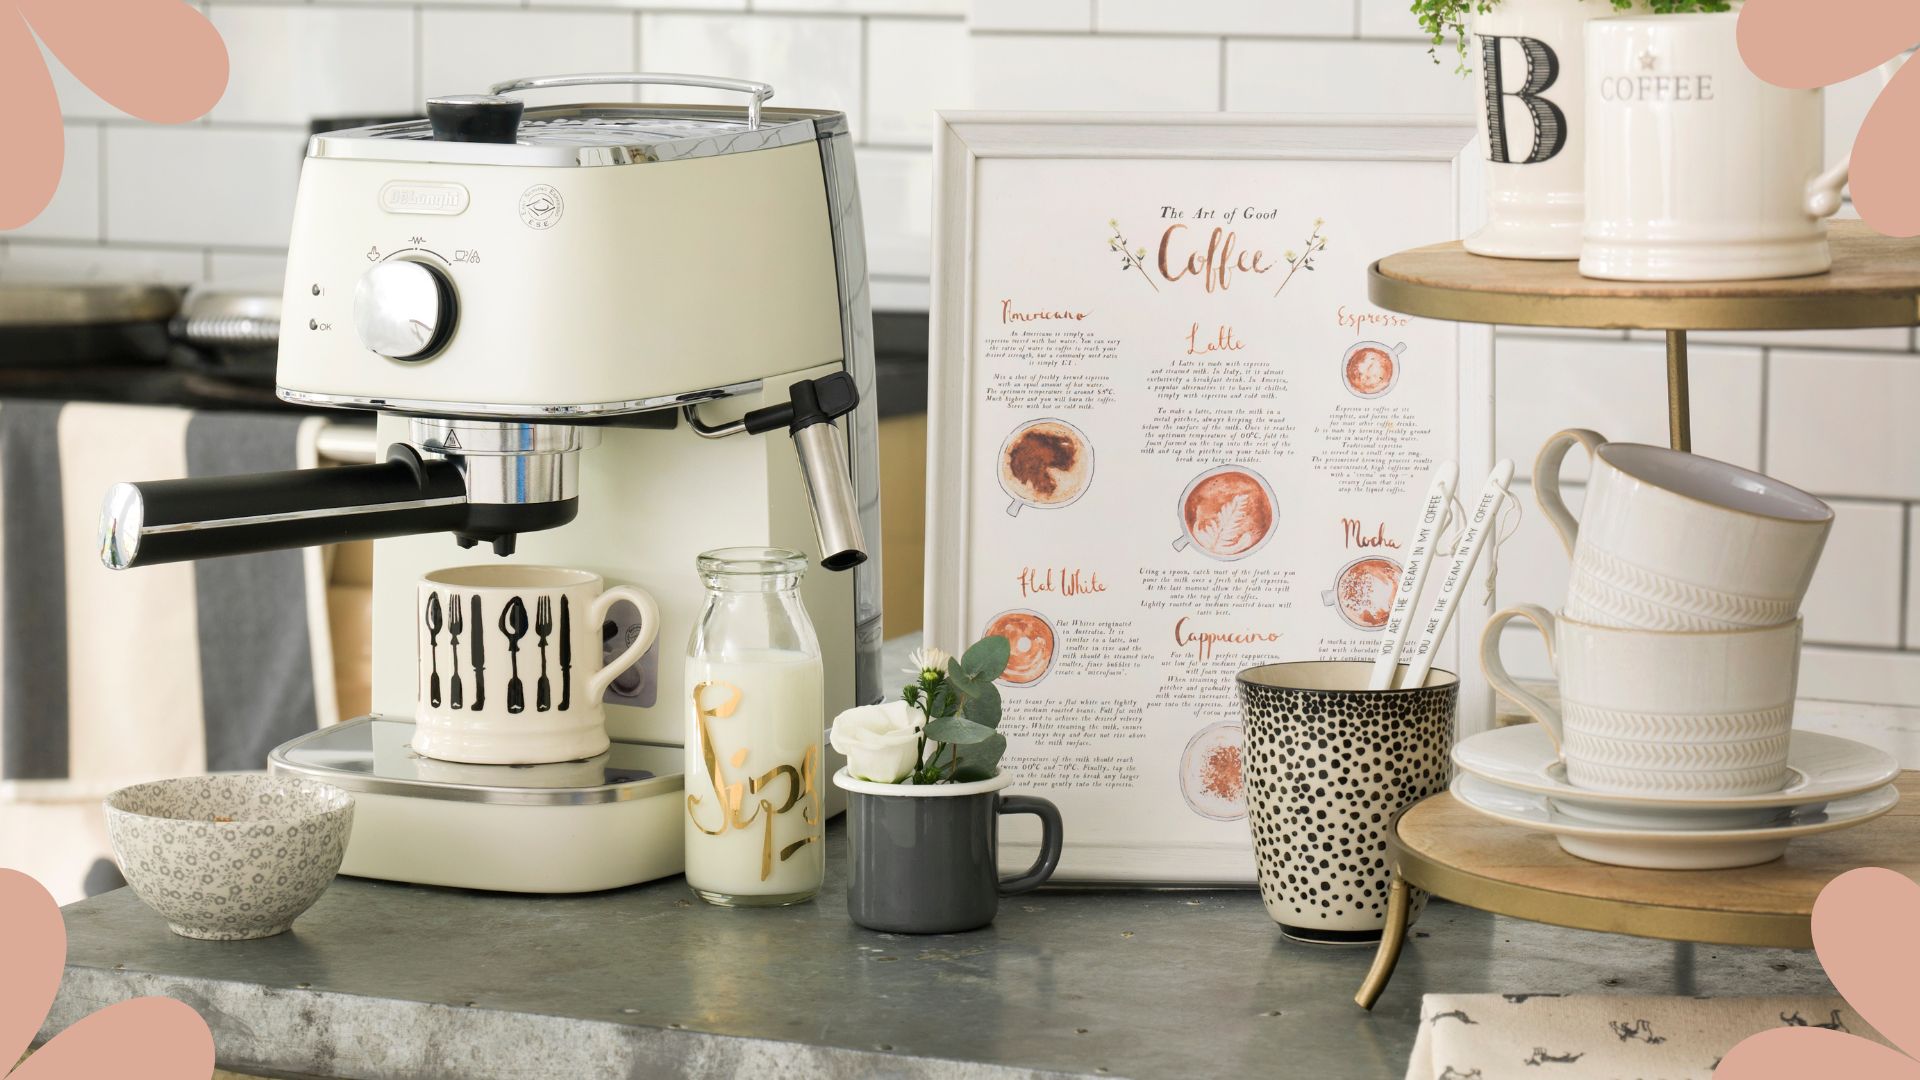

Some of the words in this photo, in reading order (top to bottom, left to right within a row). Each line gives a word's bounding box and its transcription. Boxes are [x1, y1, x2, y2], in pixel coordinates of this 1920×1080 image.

[1473, 32, 1568, 164] B
[1600, 74, 1715, 102] COFFEE
[1160, 206, 1184, 219] The
[1192, 207, 1215, 219] Art
[1224, 207, 1238, 224] of
[1244, 206, 1278, 220] Good
[1158, 223, 1274, 294] Coffee
[1001, 298, 1091, 324] Americano
[1338, 305, 1410, 336] Espresso
[320, 323, 332, 331] OK
[1186, 320, 1247, 355] Latte
[1424, 496, 1442, 524] COFFEE
[1341, 517, 1402, 549] Mocha
[1420, 528, 1431, 542] MY
[1413, 546, 1424, 555] IN
[1016, 566, 1056, 598] Flat
[1060, 567, 1107, 596] White
[1402, 560, 1420, 592] CREAM
[1417, 640, 1430, 655] YOU
[1426, 618, 1440, 634] ARE
[1434, 598, 1448, 612] THE
[1443, 560, 1464, 592] CREAM
[1459, 546, 1470, 555] IN
[1465, 528, 1478, 542] MY
[1474, 493, 1494, 523] COFFEE
[1395, 598, 1408, 612] THE
[1174, 616, 1284, 662] Cappuccino
[1388, 618, 1402, 634] ARE
[1382, 640, 1394, 655] YOU
